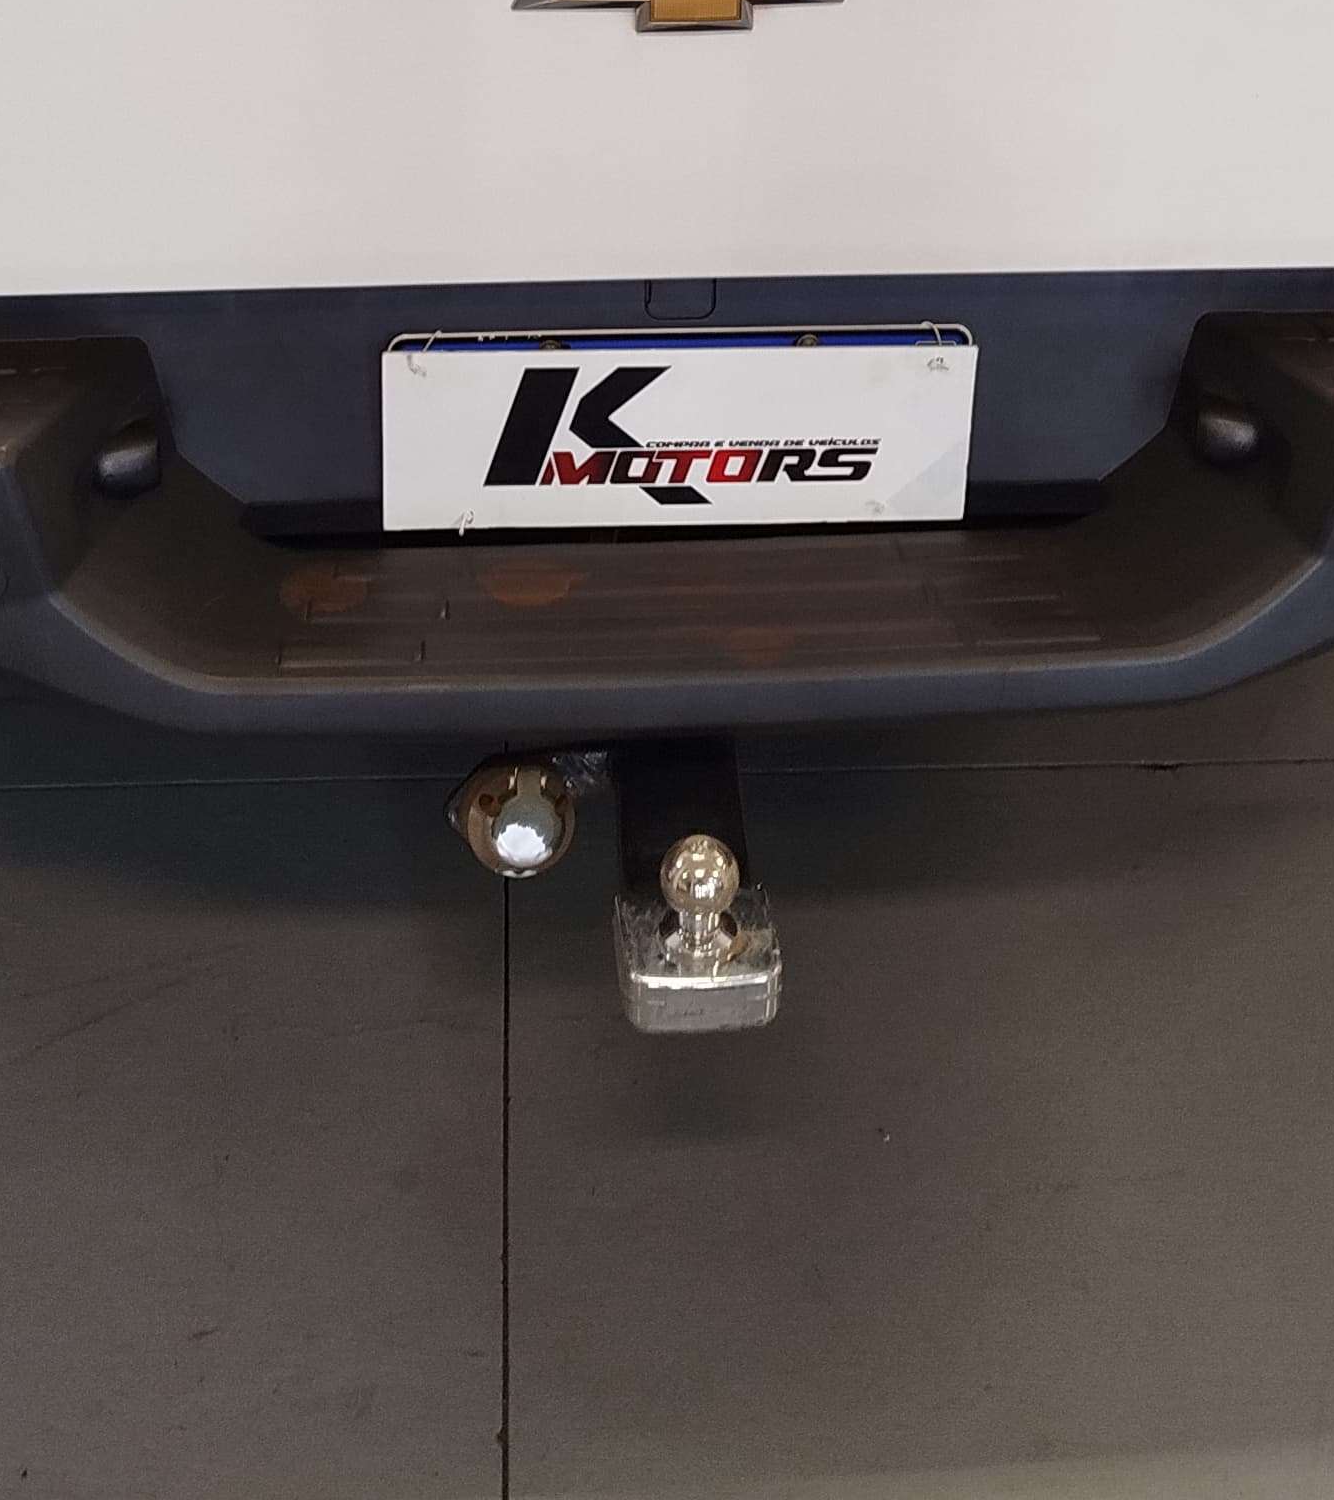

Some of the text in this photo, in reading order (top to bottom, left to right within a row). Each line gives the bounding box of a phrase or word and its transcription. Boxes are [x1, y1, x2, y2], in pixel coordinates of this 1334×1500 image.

[483, 366, 712, 505] K
[645, 440, 711, 449] COMPRA
[715, 440, 725, 448] E
[729, 439, 780, 448] VENDA
[784, 438, 805, 447] DE
[541, 448, 879, 485] MOTORS
